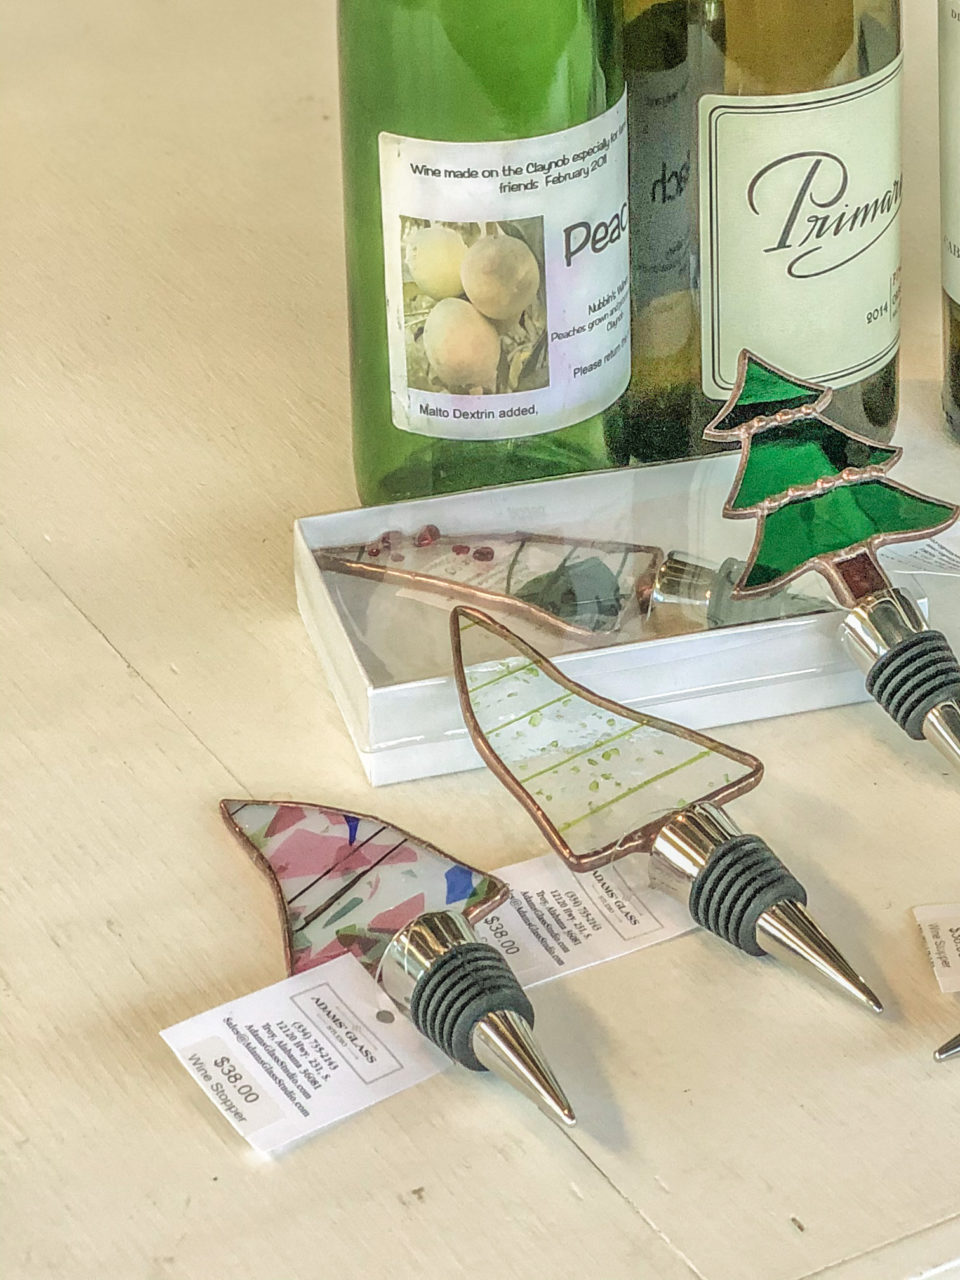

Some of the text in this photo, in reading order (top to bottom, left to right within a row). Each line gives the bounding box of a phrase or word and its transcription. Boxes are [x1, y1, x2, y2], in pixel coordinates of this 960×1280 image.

[411, 163, 441, 177] Wine
[444, 167, 479, 179] made
[482, 169, 499, 179] on
[502, 165, 523, 177] the
[525, 155, 570, 174] Claynob
[499, 179, 539, 194] friends
[545, 166, 589, 187] February
[551, 324, 586, 342] Peaches
[573, 359, 602, 378] Please
[419, 403, 449, 418] Malto
[453, 409, 495, 420] Dextrin
[614, 900, 638, 926] GLASS
[484, 916, 520, 955] $38.00
[276, 1020, 298, 1042] 12120
[275, 1040, 302, 1069] Alabama
[345, 1031, 376, 1063] GLASS
[188, 1053, 247, 1122] Wine Stopper
[214, 1056, 260, 1103] $38.00
